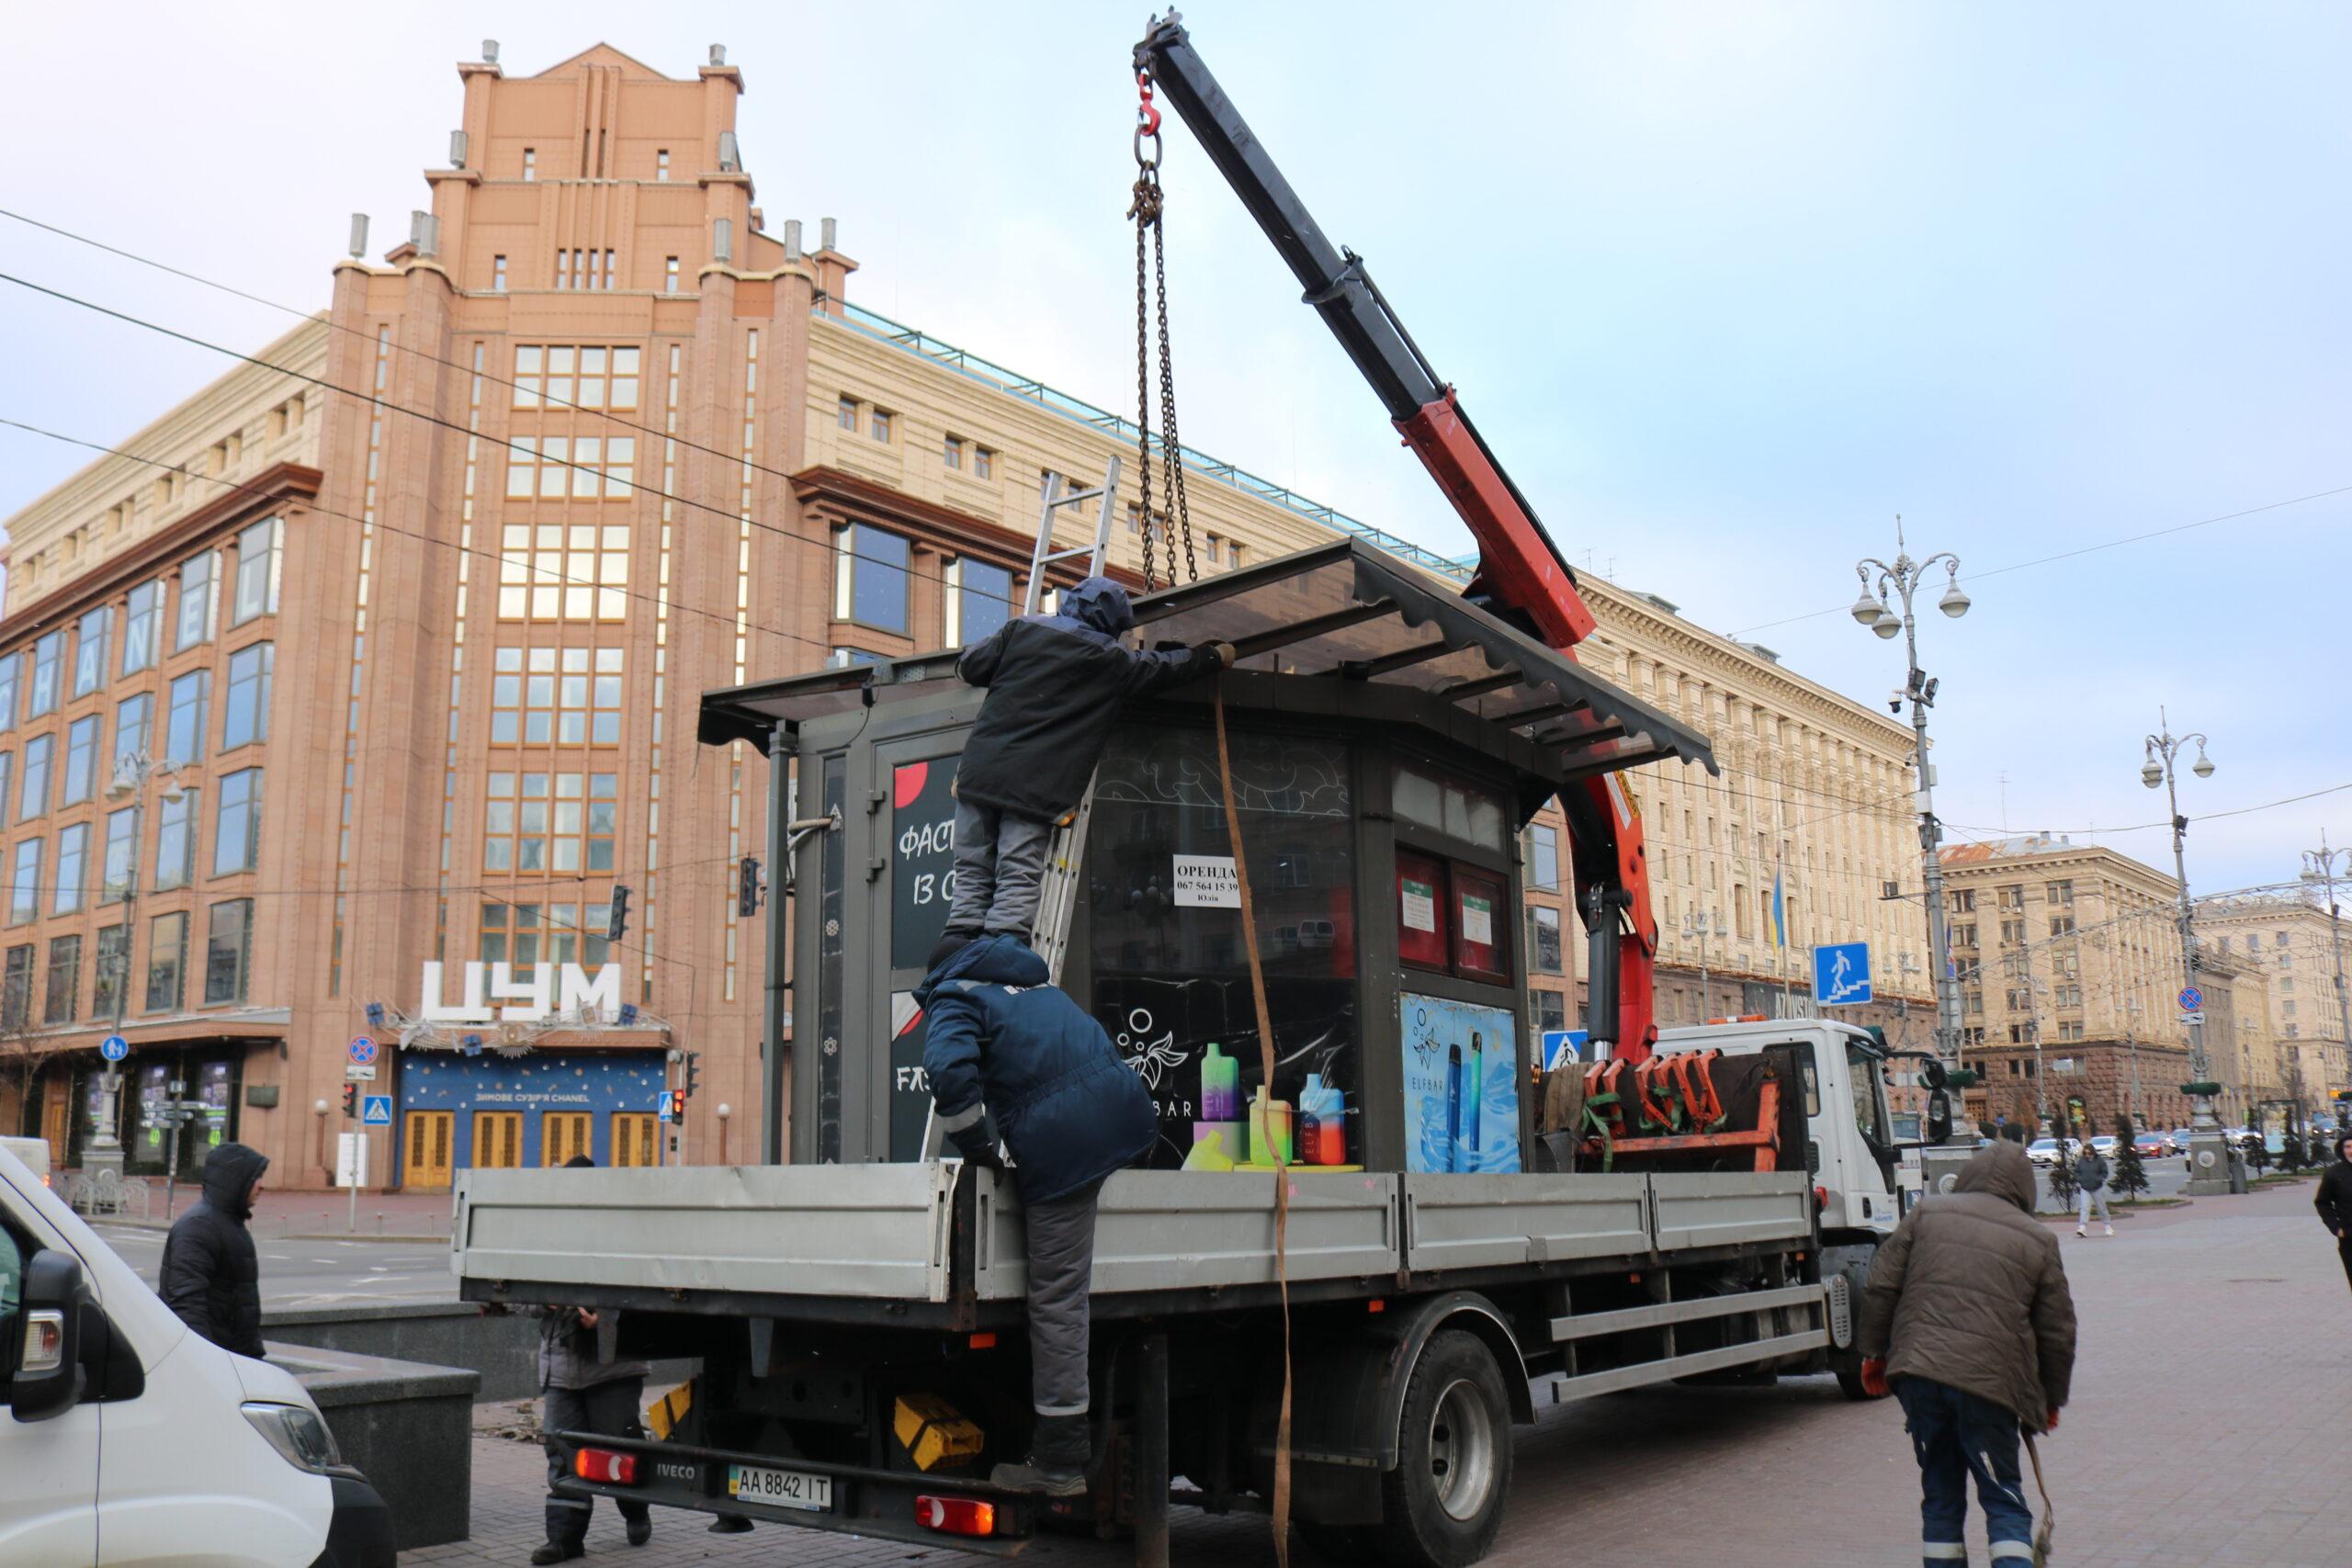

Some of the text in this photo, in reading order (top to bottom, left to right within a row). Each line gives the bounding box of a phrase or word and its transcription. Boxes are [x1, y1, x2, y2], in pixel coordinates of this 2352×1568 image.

[1177, 865, 1237, 880] ОРЕНДА
[1177, 881, 1238, 892] 067 564 15 39
[422, 960, 621, 1021] ЦУМ
[1412, 1077, 1442, 1092] ELFBAR
[476, 1093, 513, 1101] ЗИМОВЕ
[551, 1093, 590, 1102] CHANEL
[657, 1463, 695, 1479] IVECO
[740, 1470, 827, 1501] AA 8842 IT
